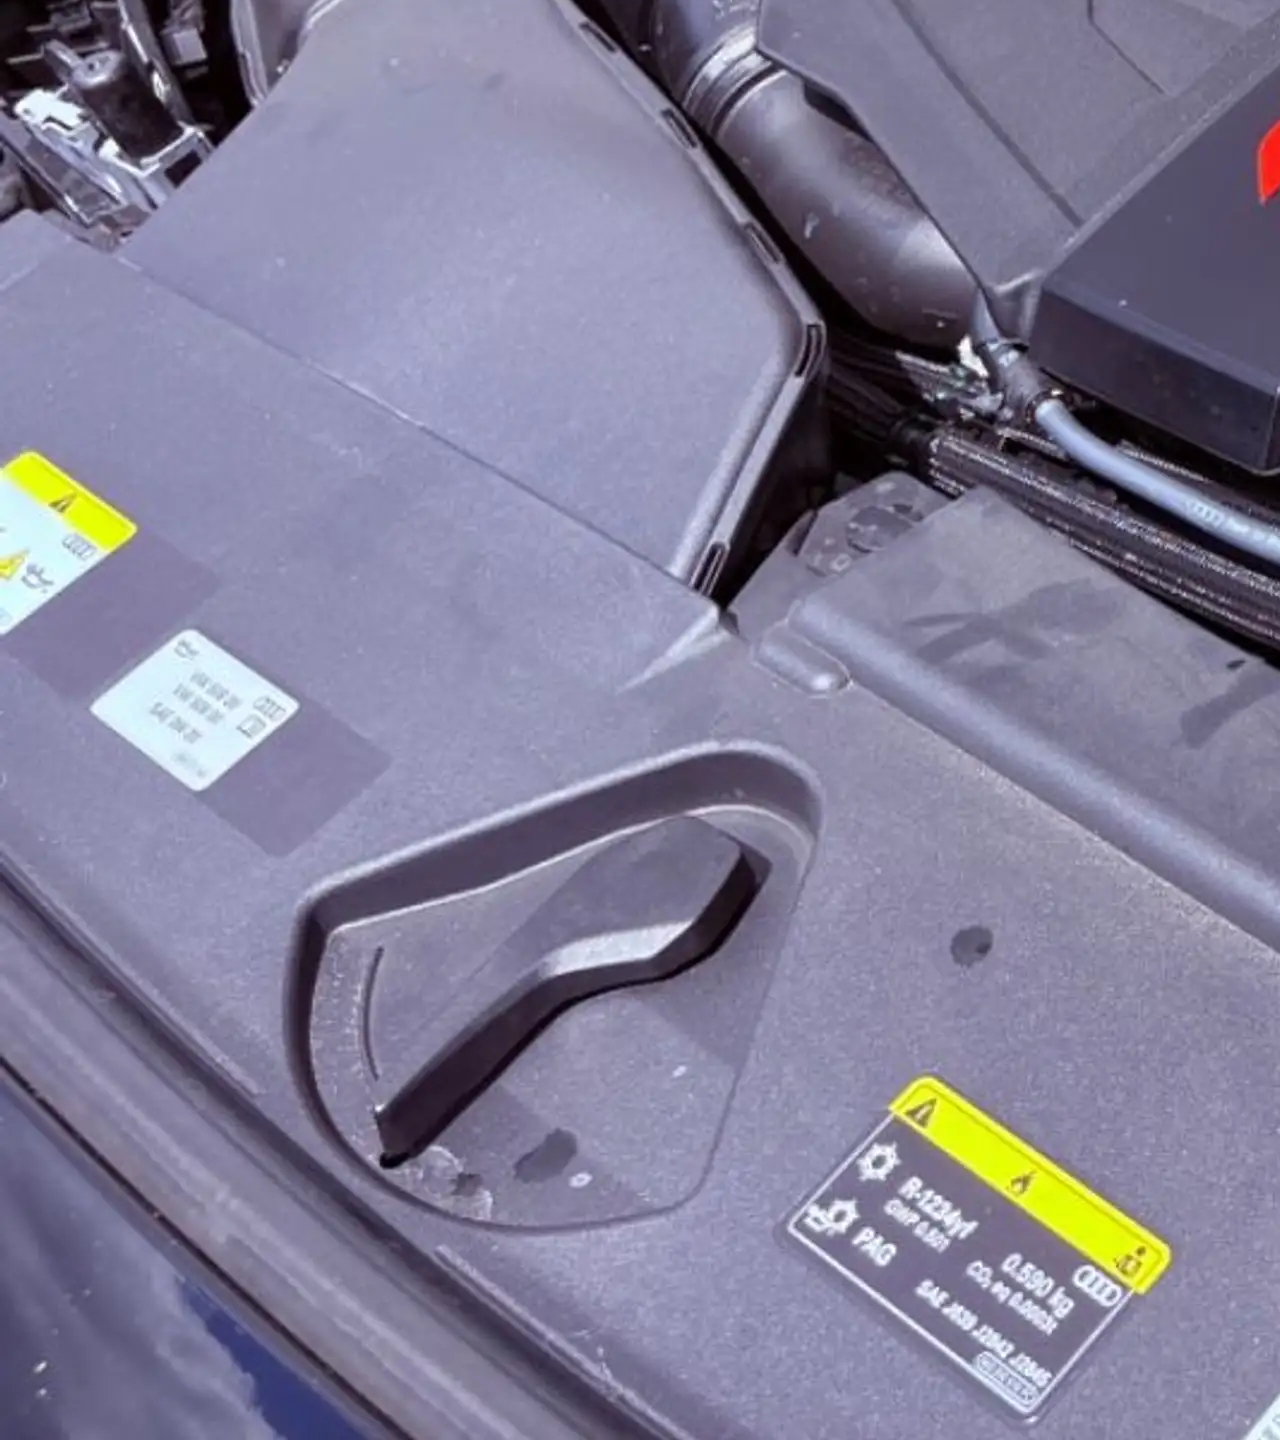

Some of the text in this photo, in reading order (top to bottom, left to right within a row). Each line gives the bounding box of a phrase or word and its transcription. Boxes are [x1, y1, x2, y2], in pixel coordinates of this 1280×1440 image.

[898, 1176, 979, 1240] R-1234yf
[852, 1225, 897, 1267] PAG
[915, 1279, 949, 1308] SAE
[1001, 1252, 1075, 1318] 0.590 kg
